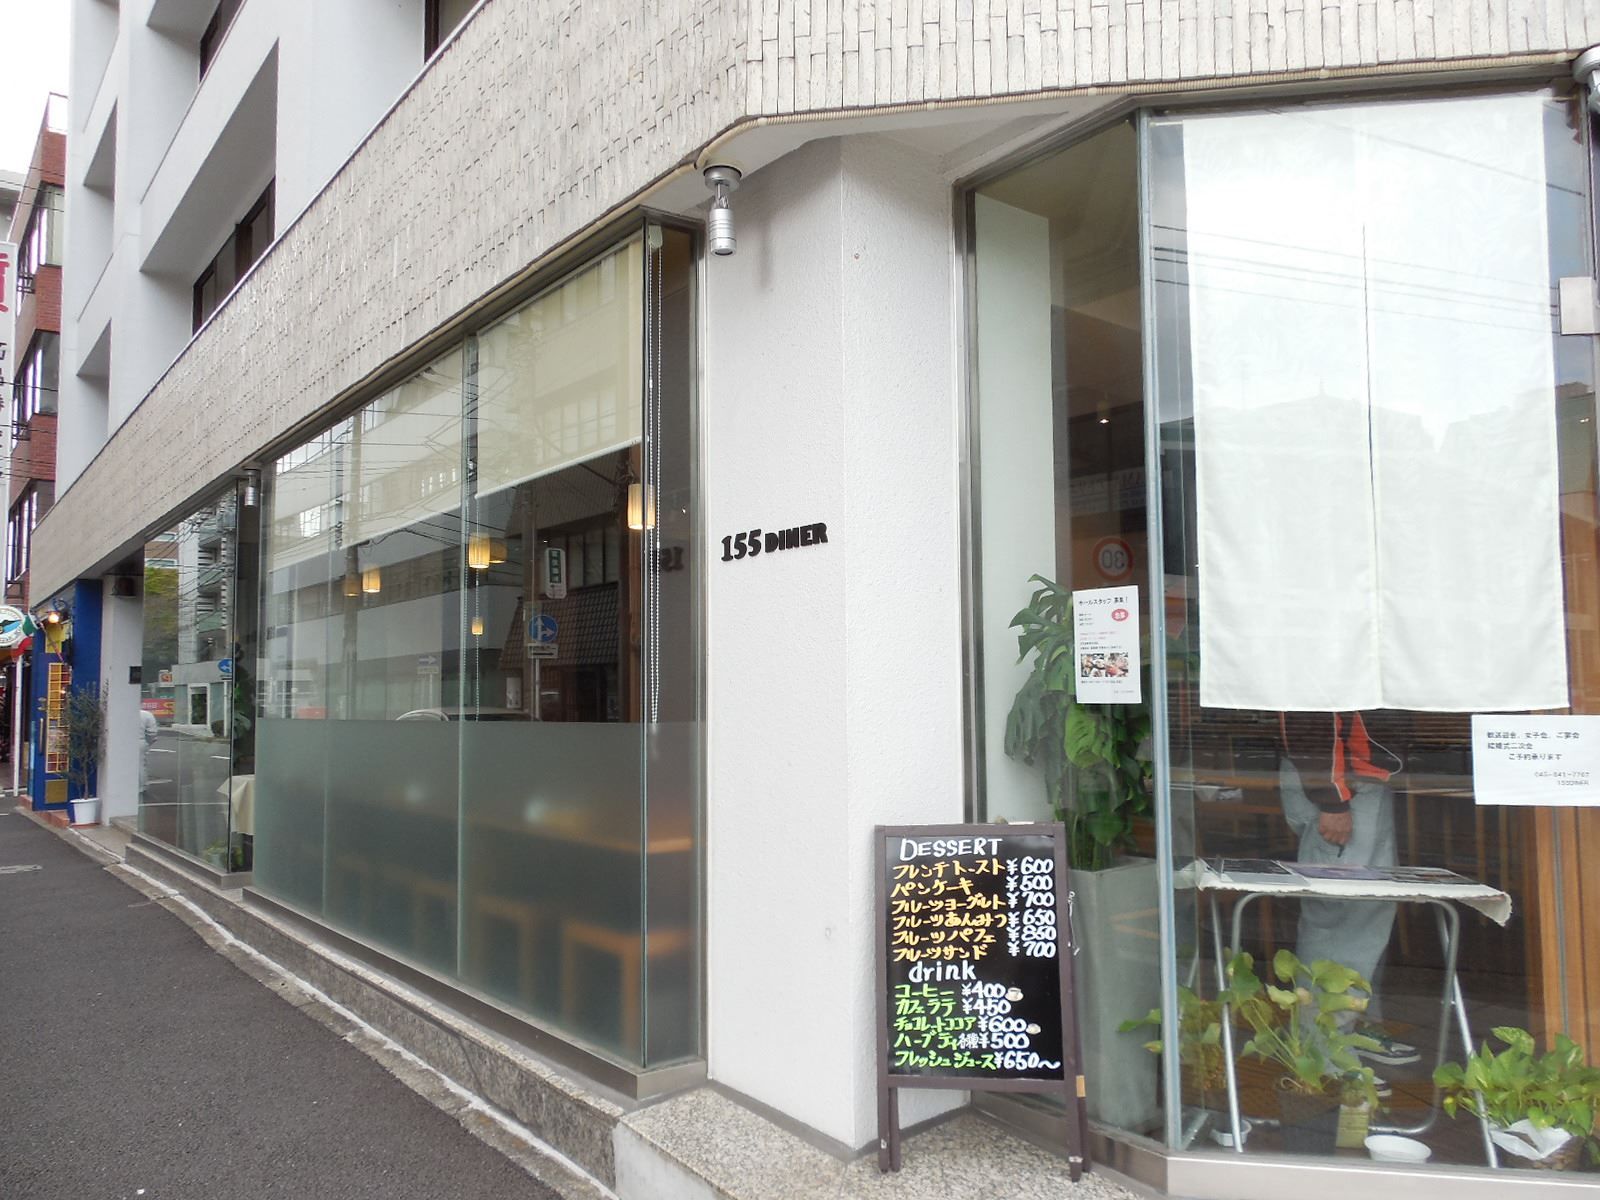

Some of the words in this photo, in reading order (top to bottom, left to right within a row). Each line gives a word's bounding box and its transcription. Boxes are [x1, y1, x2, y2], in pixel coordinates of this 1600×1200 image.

[721, 529, 762, 561] 155
[765, 522, 828, 553] DINER
[900, 837, 1003, 861] DESSERT
[1006, 856, 1054, 875] ¥600
[890, 877, 974, 898] パンケーキ
[1006, 875, 1053, 892] ¥500
[892, 893, 1007, 914] フルーツヨーグルト
[1006, 891, 1055, 908] ¥700
[892, 912, 1008, 930] フルーツあんみつ
[1008, 909, 1056, 928] ¥650
[892, 928, 996, 945] フルーツパフェ
[892, 943, 989, 962] フルーツサンド
[1008, 941, 1057, 958] ¥700
[908, 960, 977, 982] drink
[894, 983, 955, 998] コーヒー
[961, 981, 1006, 998] ¥400
[962, 999, 1011, 1016] ¥450
[978, 1016, 1027, 1033] ¥600
[894, 1051, 998, 1070] フレッシュジュース
